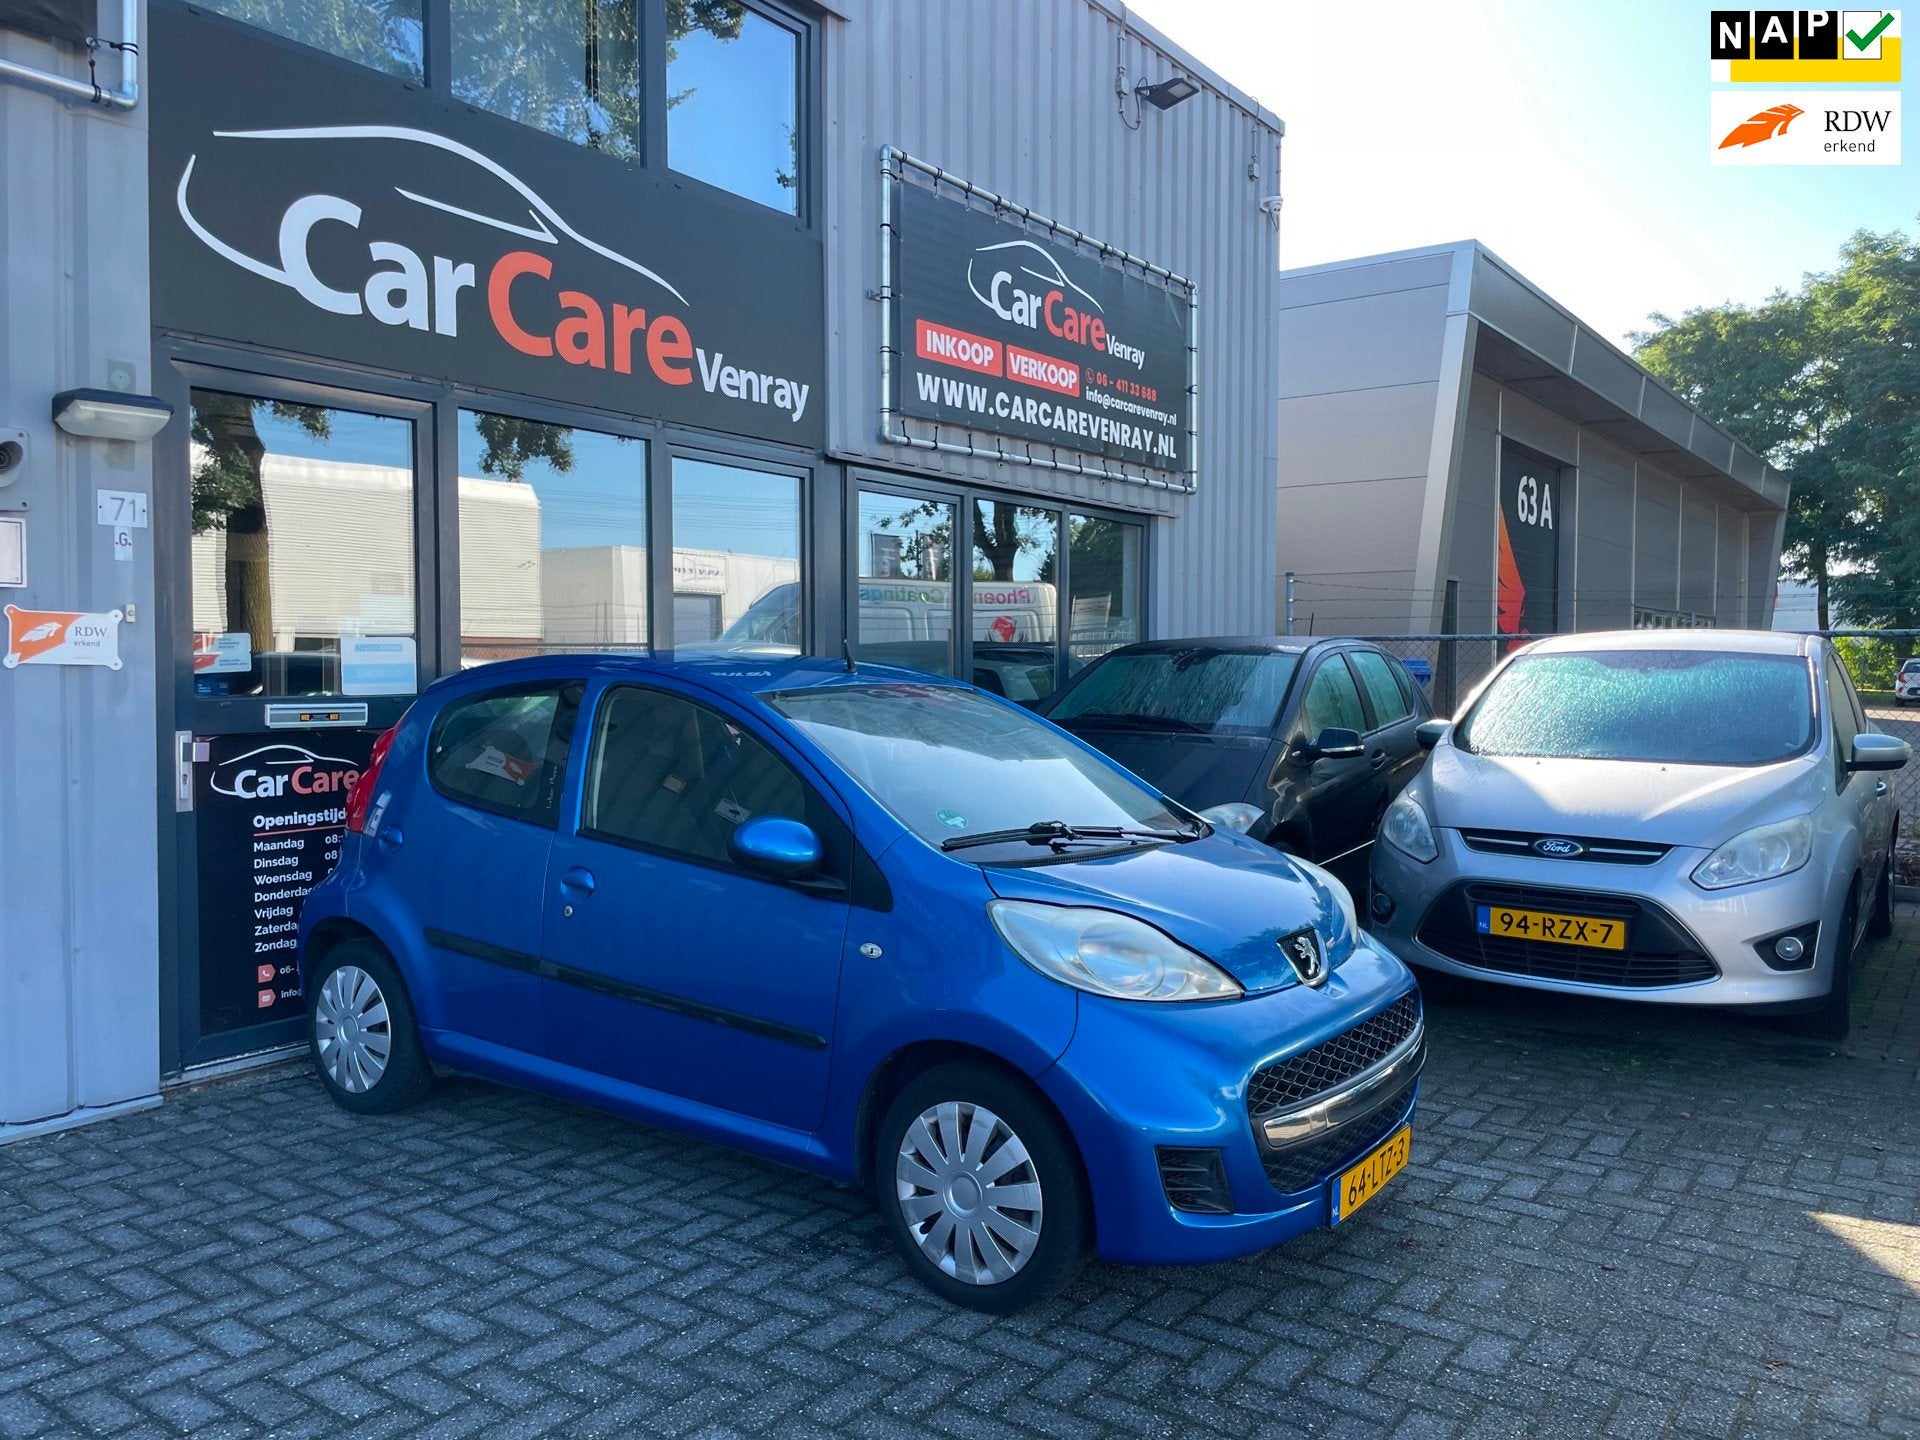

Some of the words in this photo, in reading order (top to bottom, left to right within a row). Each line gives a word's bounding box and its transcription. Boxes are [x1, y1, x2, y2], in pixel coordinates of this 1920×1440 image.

[926, 328, 994, 367] INKOOP
[1105, 333, 1145, 371] Venray
[1009, 352, 1078, 390] VERKOOP
[1096, 372, 1107, 387] 06
[695, 347, 810, 423] Venray
[915, 371, 1177, 459] WWW.CARCAREVENRAY.NL
[1085, 386, 1177, 427] info@carcarevenray.nl
[109, 496, 136, 523] 71
[74, 626, 108, 637] RDW
[253, 838, 305, 853] Maandag
[325, 834, 344, 844] 08:
[1542, 840, 1571, 854] Ford
[253, 855, 299, 869] Dinsdag
[253, 870, 313, 886] Woensdag
[254, 906, 294, 919] Vrijdag
[254, 921, 299, 936] Zaterda
[1500, 912, 1614, 944] 94-RZX-7
[254, 939, 298, 953] Zondag
[1348, 1137, 1405, 1207] 64-LTZ-3
